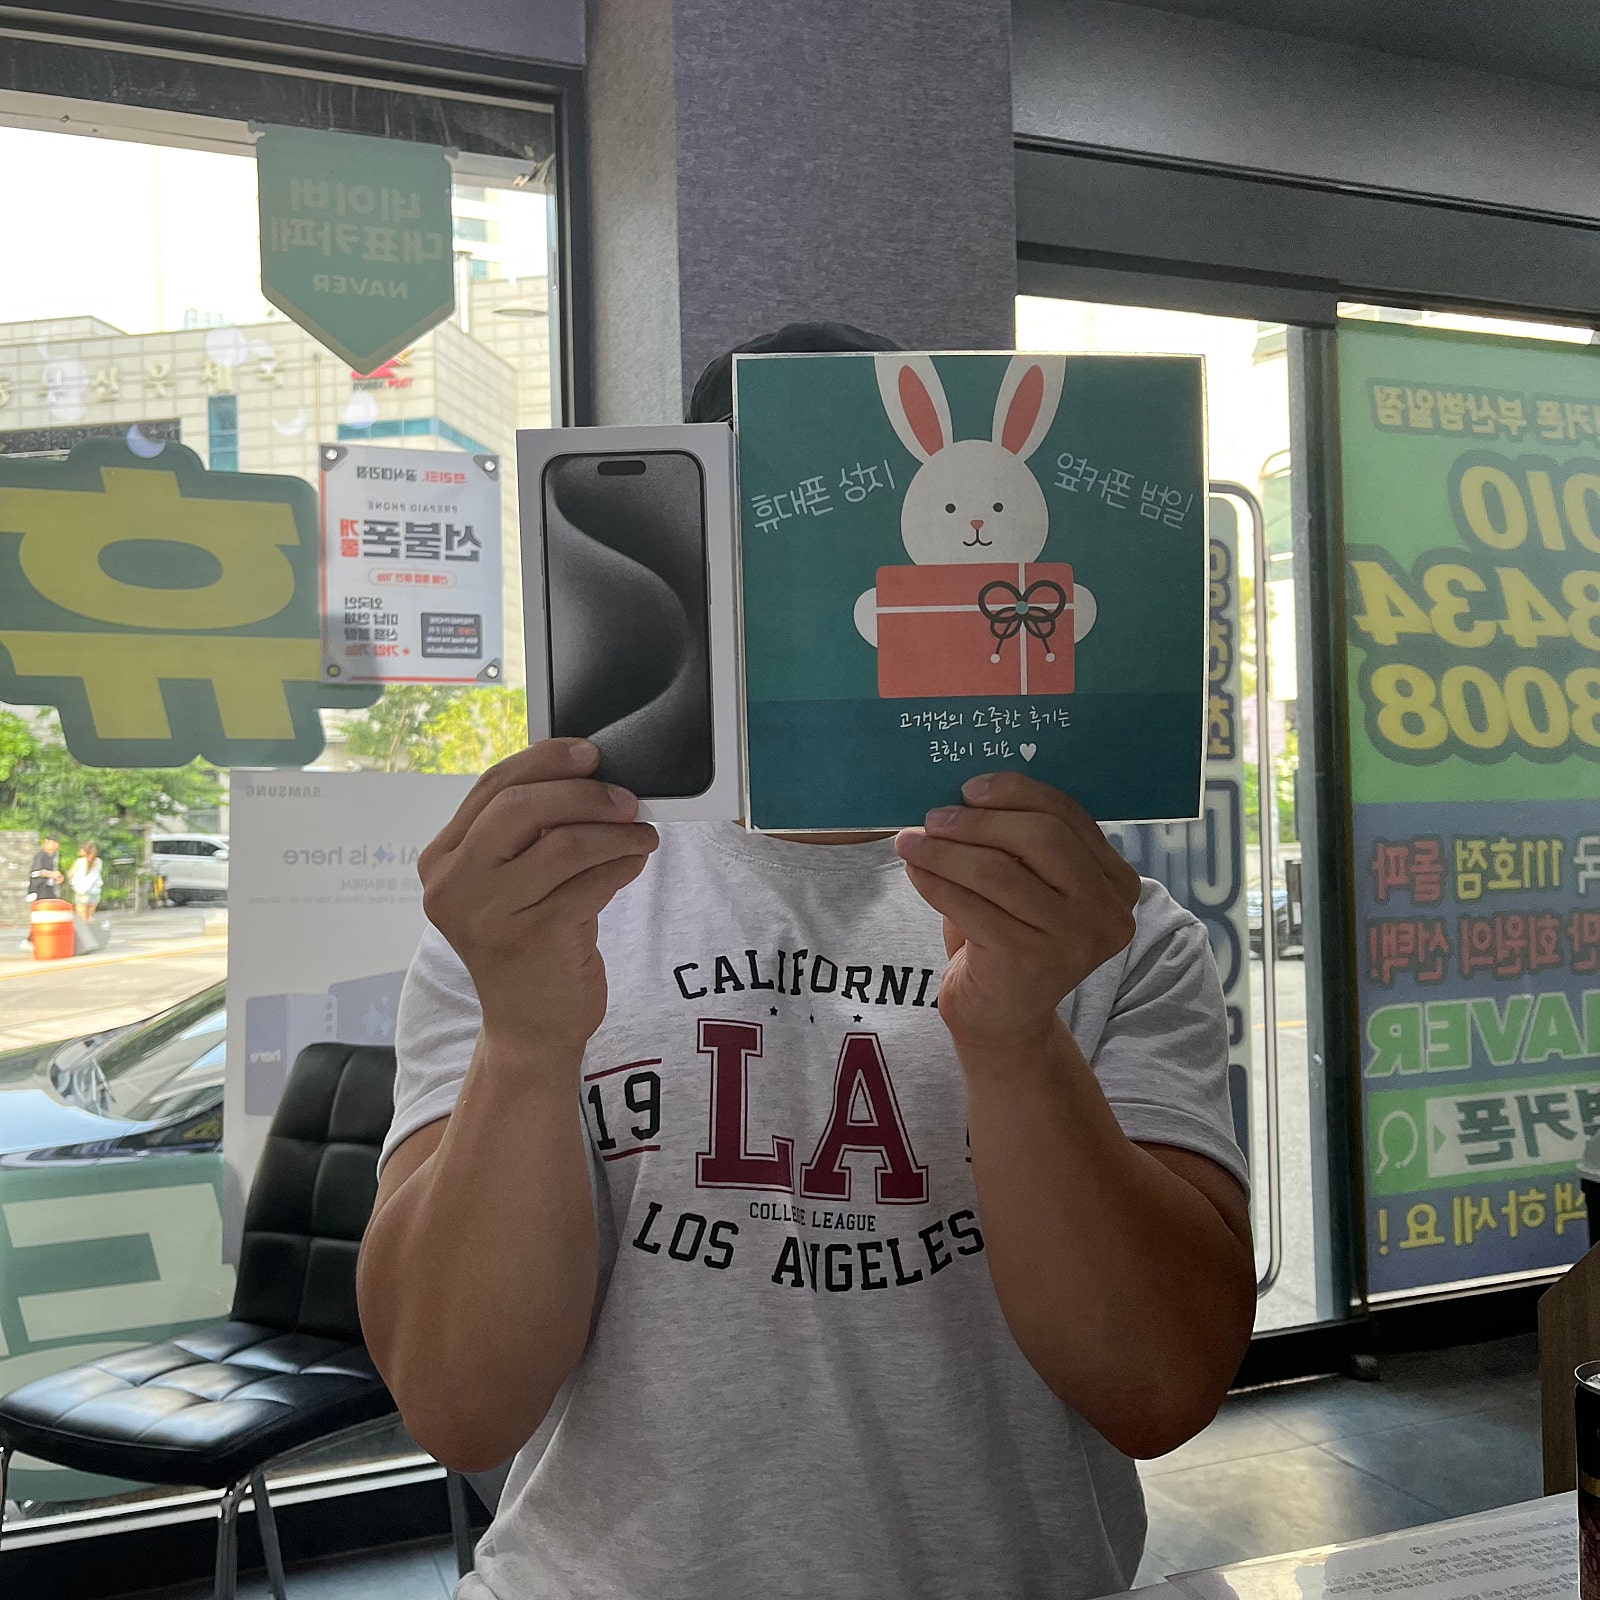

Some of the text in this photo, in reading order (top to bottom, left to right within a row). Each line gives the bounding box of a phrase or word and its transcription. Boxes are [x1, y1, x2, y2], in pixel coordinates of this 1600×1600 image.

[751, 459, 896, 533] 휴대폰 성지
[1053, 452, 1193, 529] 옆커폰 범일
[899, 705, 1071, 733] 고객님의 소중한 후기는
[929, 740, 1015, 763] 큰힘이 되요
[673, 949, 939, 1008] CALIFORNI
[588, 1071, 661, 1150] 19
[696, 1017, 929, 1205] LA
[633, 1202, 985, 1293] LOS ANGELES
[812, 1211, 876, 1232] LEAGUE
